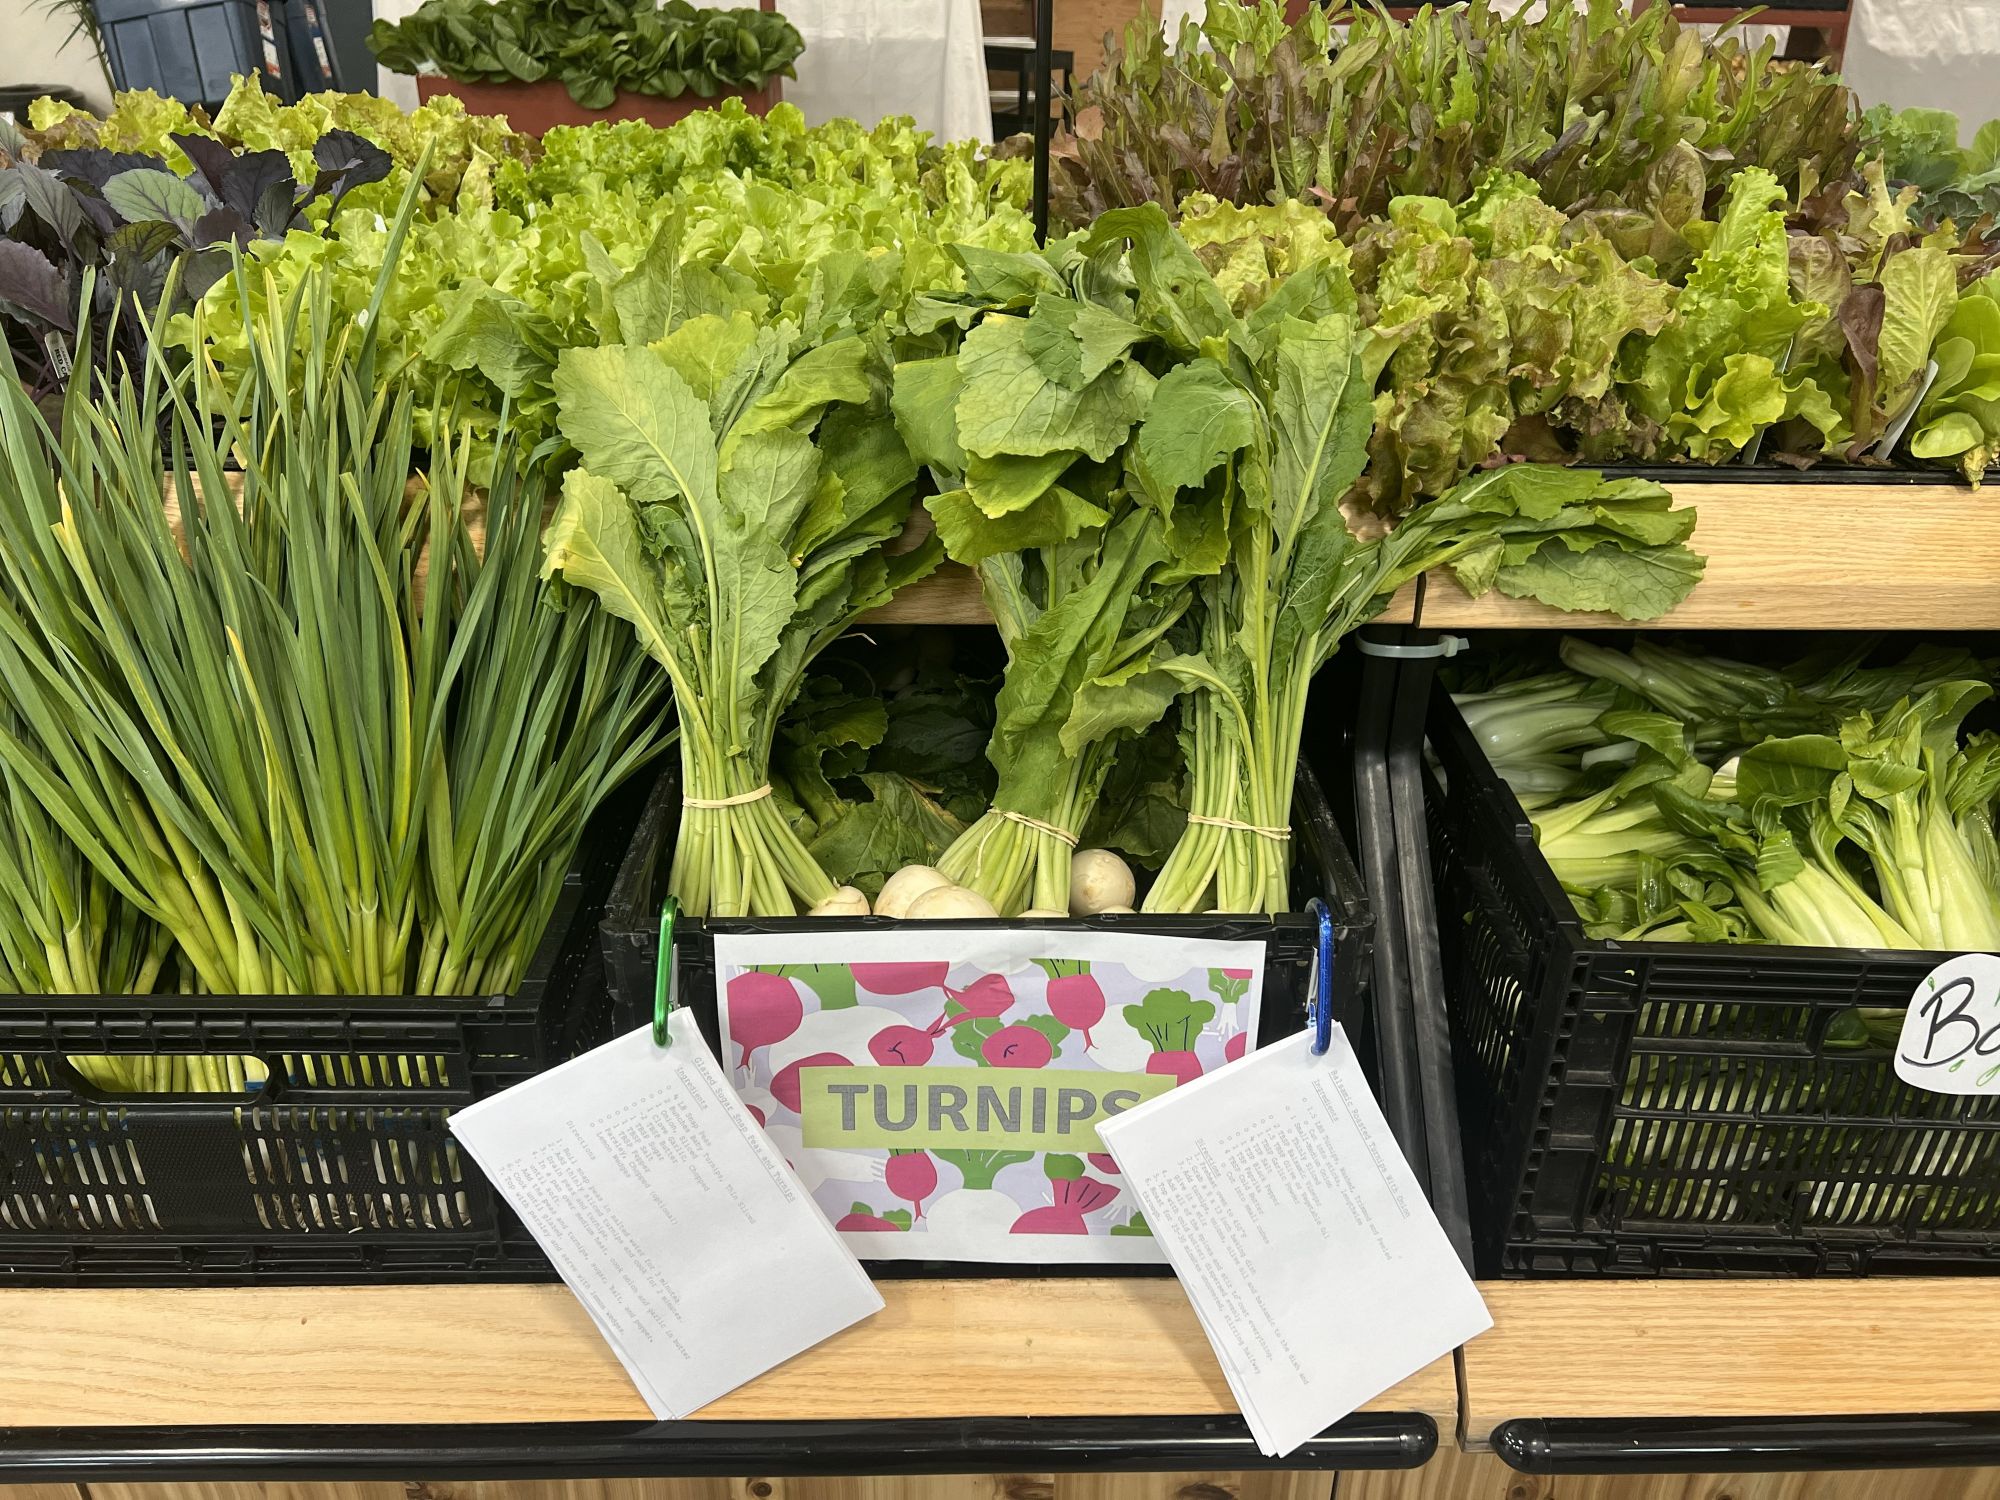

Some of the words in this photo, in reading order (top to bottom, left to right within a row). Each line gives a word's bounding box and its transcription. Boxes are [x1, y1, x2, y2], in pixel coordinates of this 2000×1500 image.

[54, 348, 64, 365] RED
[675, 1066, 709, 1110] Ingredients
[828, 1084, 1142, 1134] TURNIPS
[1312, 1079, 1339, 1122] Ingredients
[565, 1119, 597, 1161] Directions
[682, 1111, 699, 1130] Snap
[693, 1056, 716, 1085] Glazed
[713, 1087, 734, 1112] Sugar
[731, 1112, 749, 1133] Snap
[747, 1134, 763, 1153] Peas
[771, 1170, 797, 1202] Turnips
[646, 1140, 665, 1162] Sugar
[1196, 1137, 1222, 1177] Directions
[1330, 1069, 1353, 1107] Balsamic
[1351, 1109, 1371, 1140] Roasted
[1366, 1141, 1388, 1173] Turnips
[1385, 1174, 1399, 1193] With
[1395, 1194, 1411, 1217] Onion
